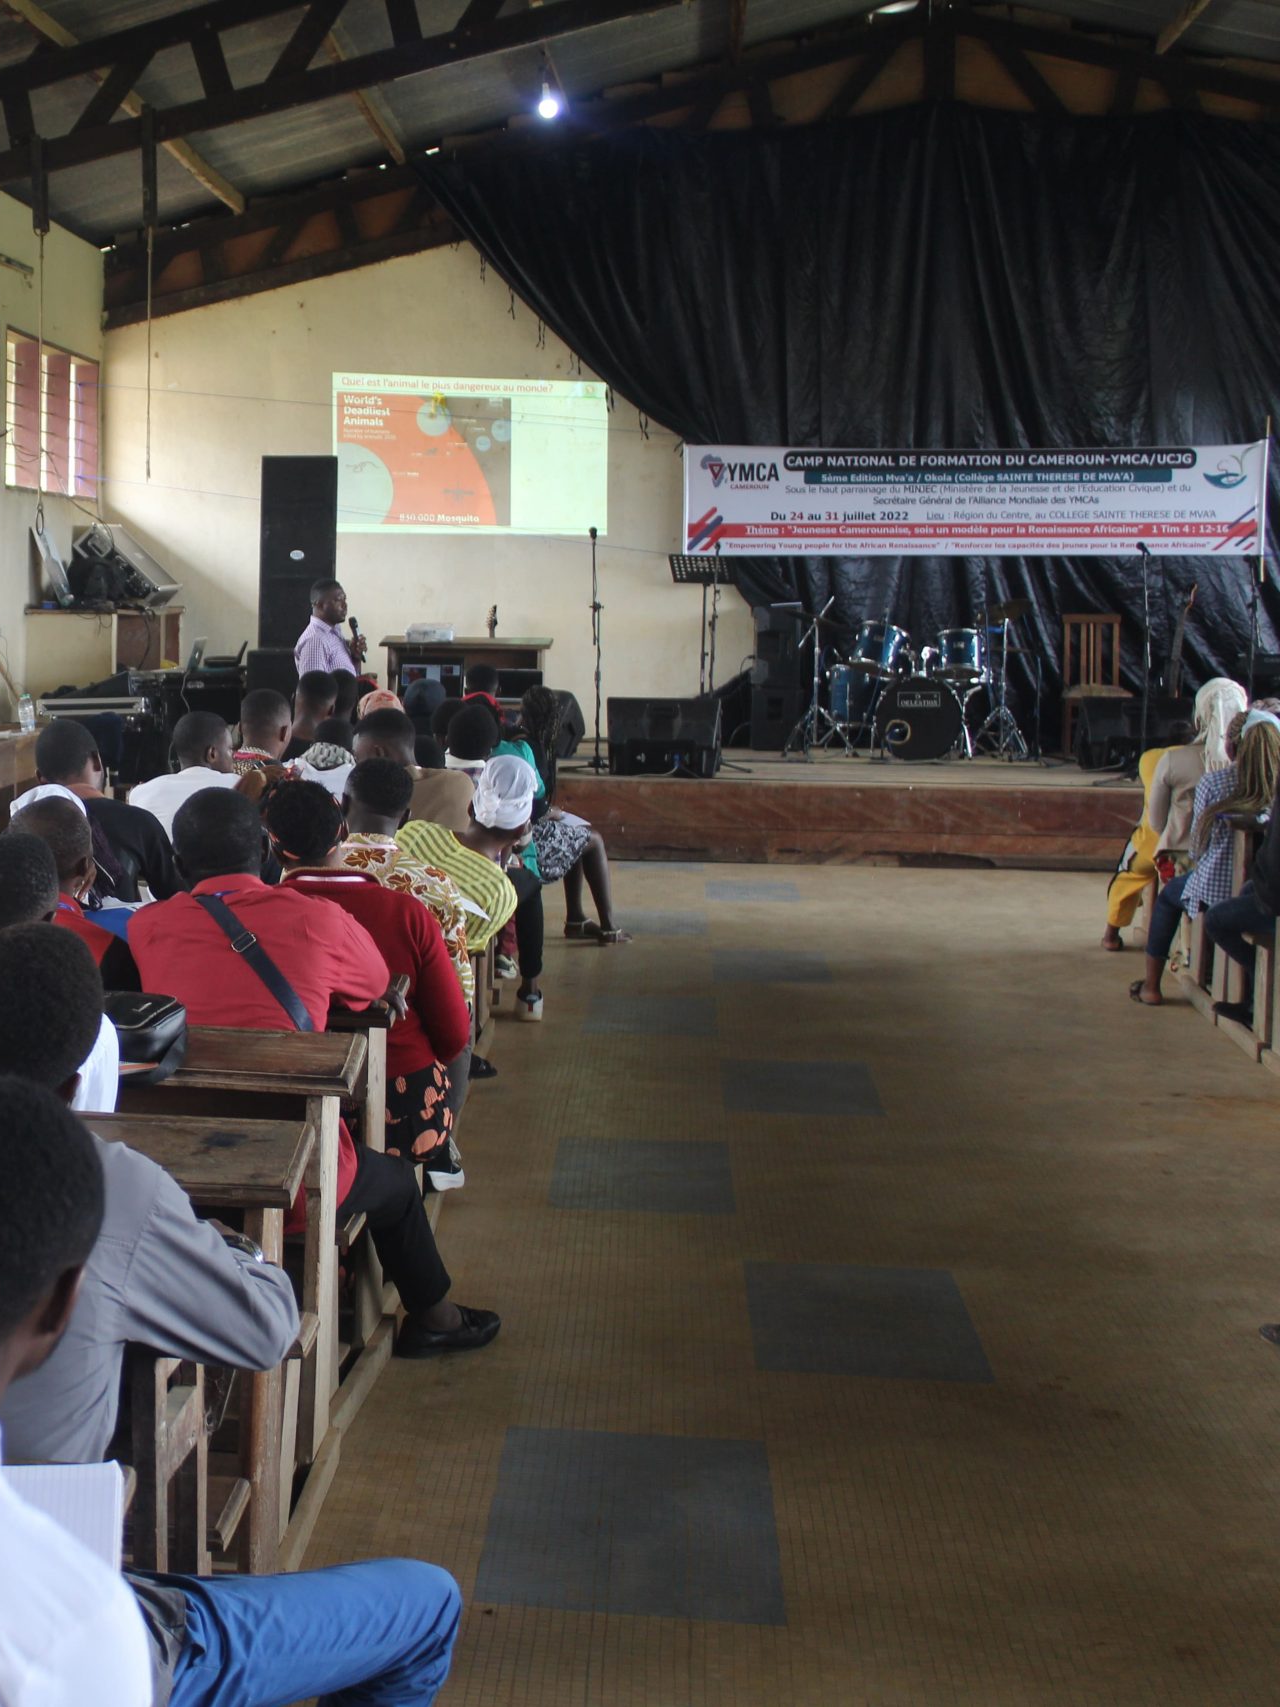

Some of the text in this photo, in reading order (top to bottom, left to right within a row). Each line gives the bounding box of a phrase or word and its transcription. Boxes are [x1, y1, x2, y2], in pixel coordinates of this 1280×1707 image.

[342, 377, 364, 386] Quel
[383, 378, 419, 388] l'animal
[432, 381, 451, 392] plus
[453, 382, 501, 393] dangereux
[504, 384, 514, 392] au
[517, 384, 553, 393] monde?
[343, 394, 382, 405] World's
[343, 406, 391, 416] Deadliest
[343, 417, 384, 426] Animals
[786, 453, 1193, 467] CAMP NATIONAL DE FORMATION DU CAMEROUN-YMCA/UCJG
[727, 462, 780, 482] YMCA
[821, 473, 848, 482] 5ème
[850, 473, 883, 482] Edition
[886, 473, 914, 482] Mva'a
[924, 473, 952, 482] Okola
[955, 472, 995, 483] (Collège
[997, 473, 1033, 482] SAINTE
[1036, 472, 1080, 481] THERESE
[1082, 472, 1096, 481] DE
[1099, 472, 1134, 482] MVA'A)
[785, 485, 806, 494] Sous
[808, 485, 816, 494] le
[819, 485, 838, 494] haut
[841, 484, 887, 496] parrainage
[889, 484, 900, 494] du
[904, 484, 938, 494] MINJEC
[940, 484, 983, 495] (Ministère
[985, 484, 997, 493] de
[999, 484, 1007, 493] la
[1010, 484, 1049, 493] Jeunesse
[1052, 484, 1061, 493] et
[1064, 484, 1075, 493] de
[1128, 483, 1165, 494] Civique)
[1167, 484, 1177, 492] et
[1179, 483, 1191, 492] du
[873, 495, 1100, 505] Secrétaire Général de l'Alliance Mondiale des YMCAs
[437, 514, 480, 524] Mosquito
[771, 512, 787, 520] Du
[790, 512, 804, 520] 24
[825, 512, 839, 520] 31
[842, 512, 876, 523] juillet
[879, 511, 909, 520] 2022
[926, 511, 945, 520] Lieu
[953, 510, 984, 521] Région
[986, 511, 998, 520] du
[1000, 510, 1032, 520] Centre,
[1049, 510, 1089, 519] COLLEGE
[1093, 510, 1126, 519] SAINTE
[1129, 510, 1171, 519] THERESE
[1174, 510, 1187, 518] DE
[1189, 510, 1217, 518] MVA'A
[745, 525, 779, 535] Thème
[787, 525, 837, 534] "Jeunesse
[839, 525, 911, 536] Camerounaise,
[914, 525, 934, 534] sois
[936, 526, 949, 534] un
[951, 525, 989, 534] modèle
[991, 526, 1013, 536] pour
[1016, 525, 1026, 534] la
[1028, 524, 1091, 534] Renaissance
[1093, 524, 1144, 534] Africaine"
[1152, 524, 1158, 534] 1
[1161, 524, 1180, 534] Tim
[1182, 524, 1189, 534] 4
[1199, 524, 1229, 534] 12-16
[726, 542, 776, 550] "Empowering
[778, 542, 800, 550] Young
[804, 542, 830, 550] people
[1008, 542, 1044, 550] capacités
[1062, 542, 1088, 550] jeunes
[1091, 542, 1108, 550] pour
